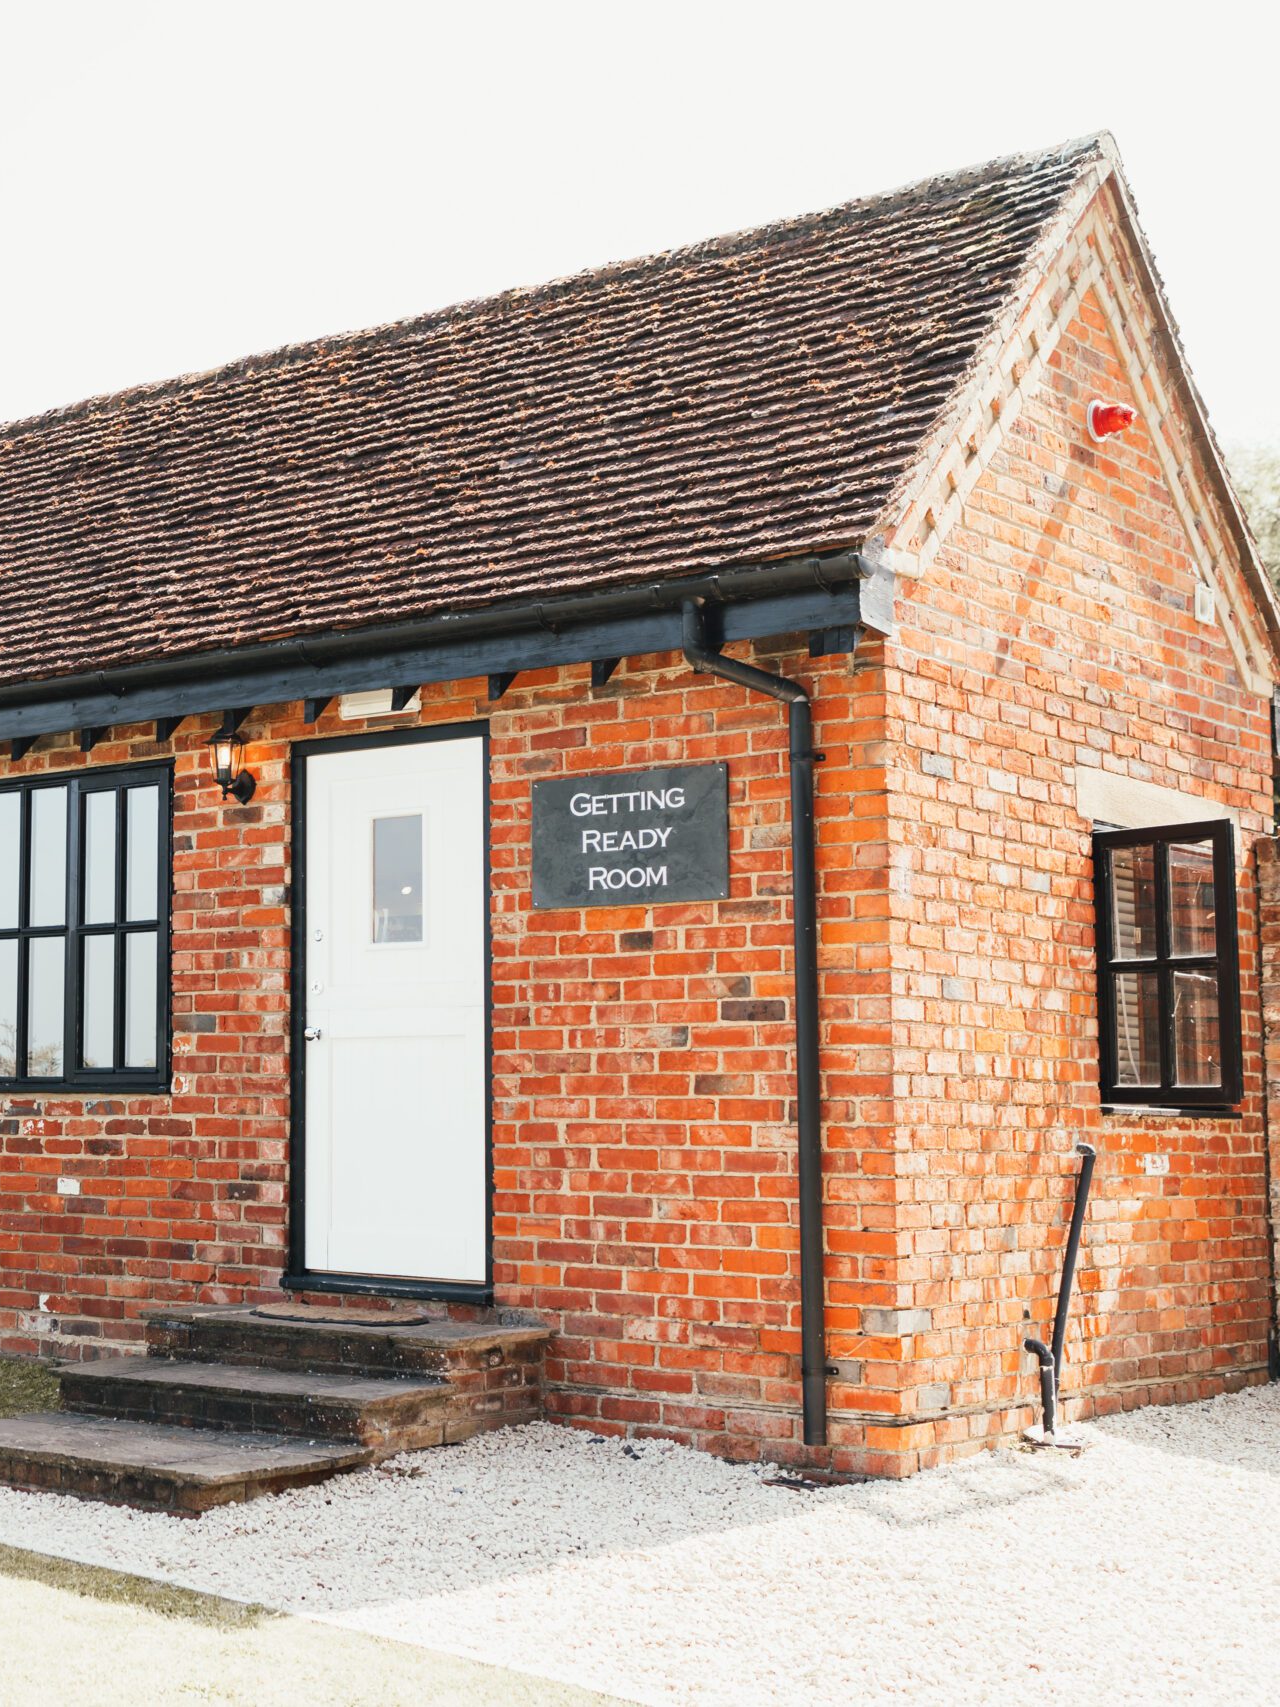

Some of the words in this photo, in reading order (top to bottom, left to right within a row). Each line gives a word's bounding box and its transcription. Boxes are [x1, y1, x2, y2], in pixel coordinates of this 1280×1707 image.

[570, 788, 685, 816] GETTING
[582, 827, 673, 853] READY
[588, 866, 668, 890] ROOM
